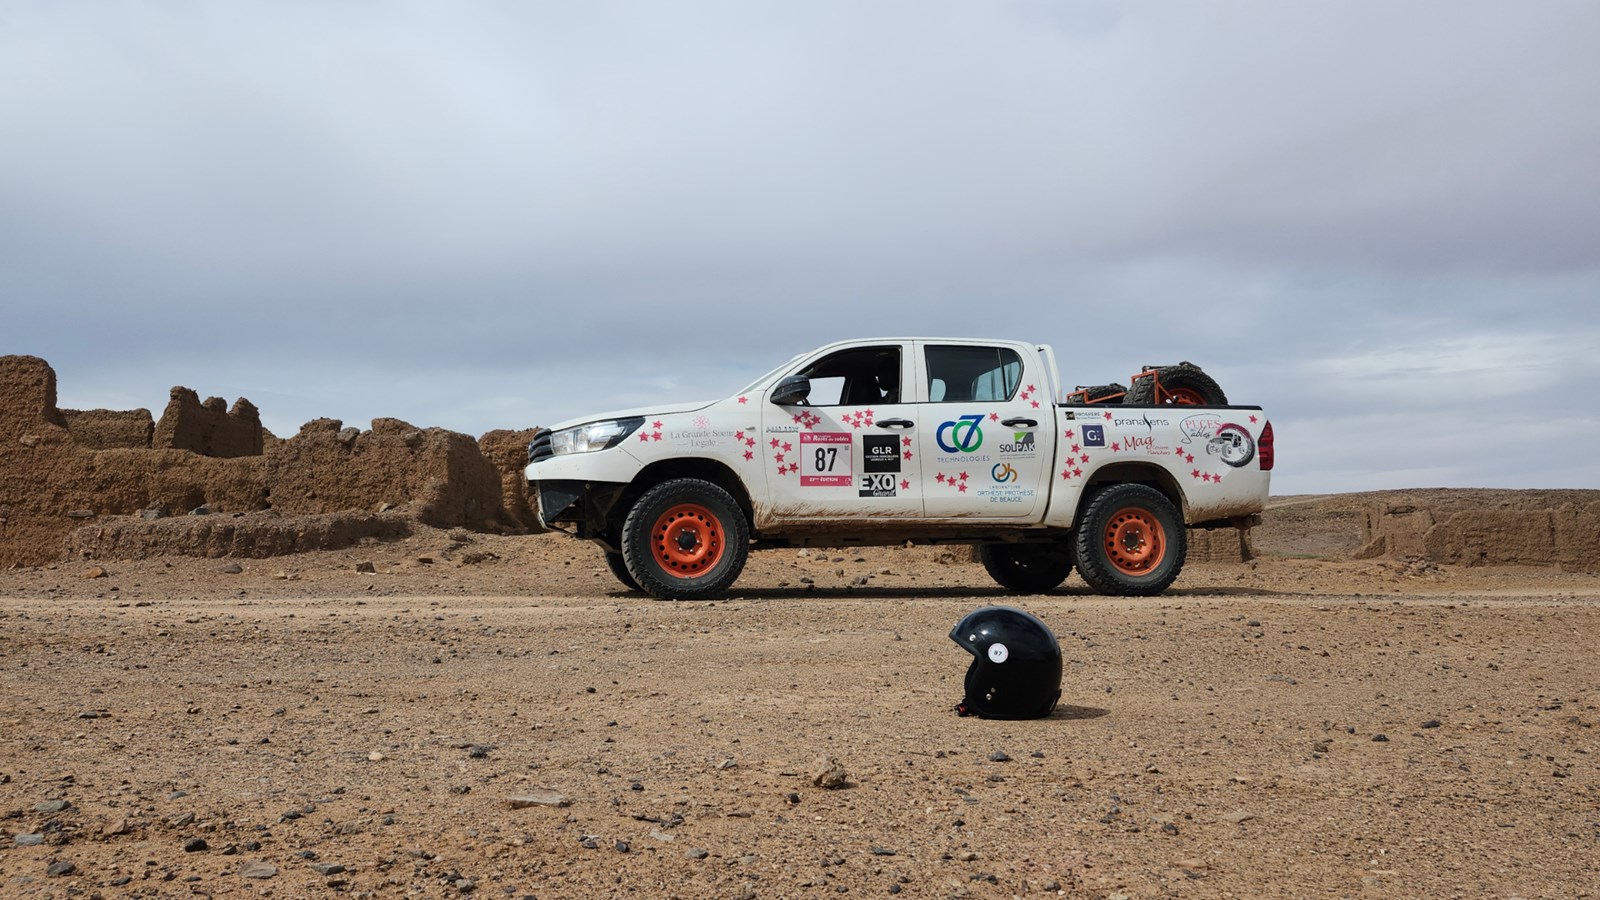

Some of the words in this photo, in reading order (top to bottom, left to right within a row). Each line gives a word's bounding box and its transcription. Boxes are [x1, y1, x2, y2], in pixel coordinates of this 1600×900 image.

[1185, 419, 1222, 429] PUCES
[670, 431, 680, 440] La
[682, 431, 711, 439] Grande
[999, 443, 1035, 453] SOLPAK
[1123, 436, 1155, 452] Mag
[871, 446, 893, 455] GLR
[815, 448, 838, 472] 87
[937, 455, 991, 463] TECHNOLOGIES
[859, 474, 895, 491] EXO
